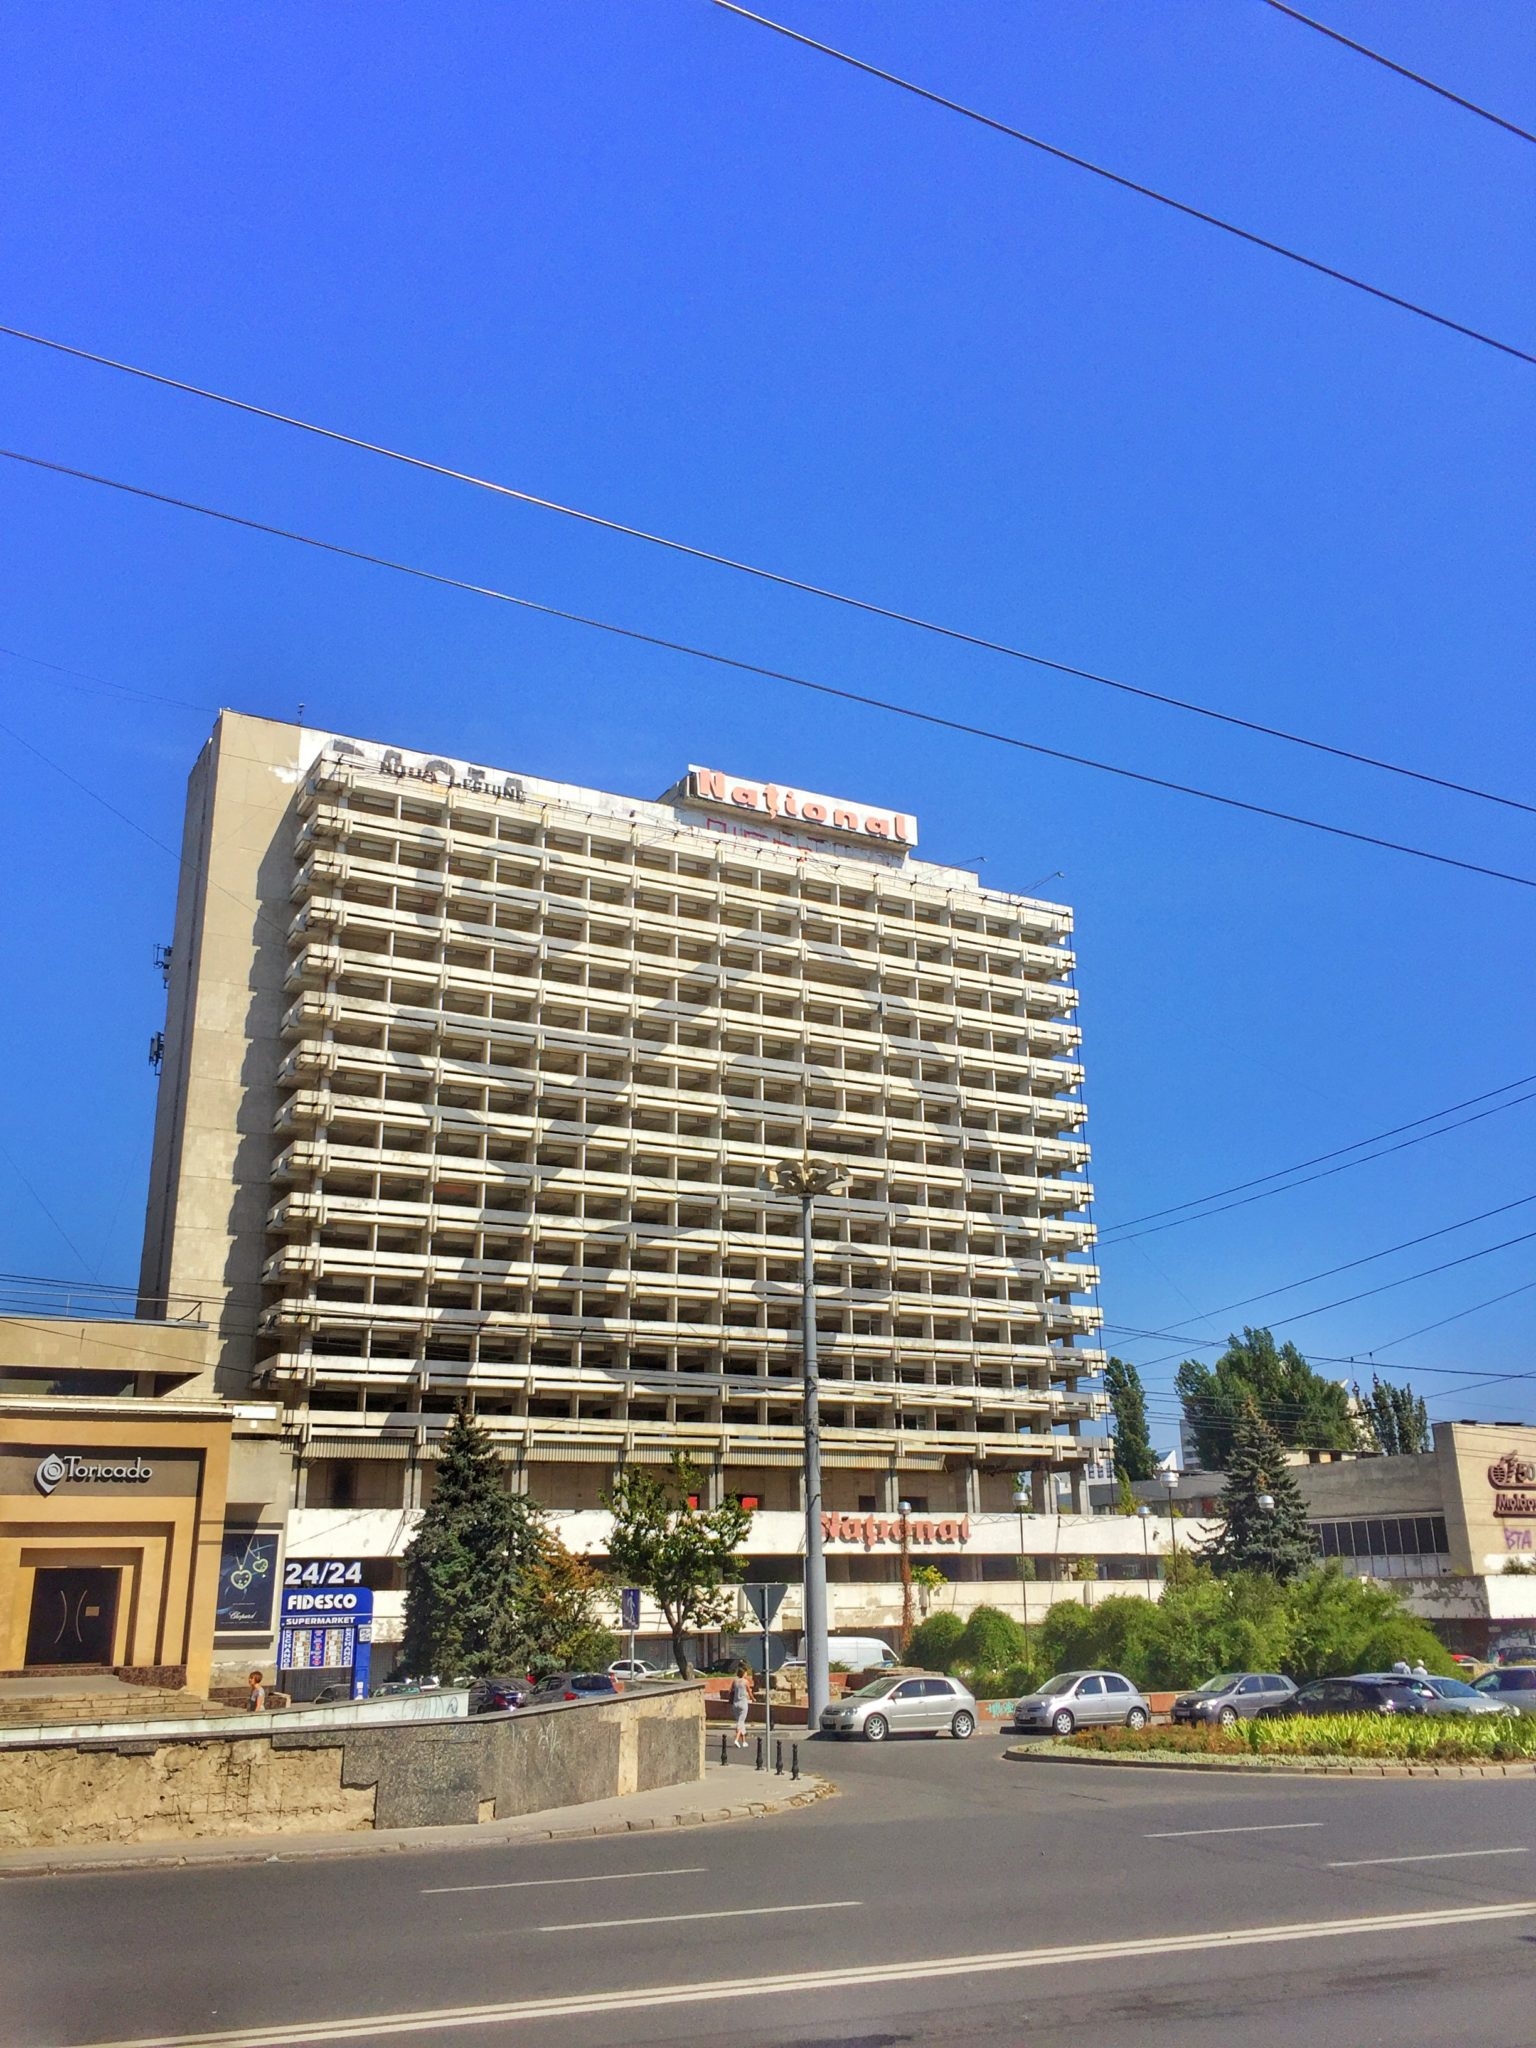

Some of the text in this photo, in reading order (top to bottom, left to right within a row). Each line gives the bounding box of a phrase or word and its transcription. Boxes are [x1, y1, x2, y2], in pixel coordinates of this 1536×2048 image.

[63, 1455, 153, 1479] Toricado
[285, 1562, 362, 1585] 24/24
[287, 1593, 357, 1611] FIDESCO
[286, 1616, 355, 1626] SUPERMARKET
